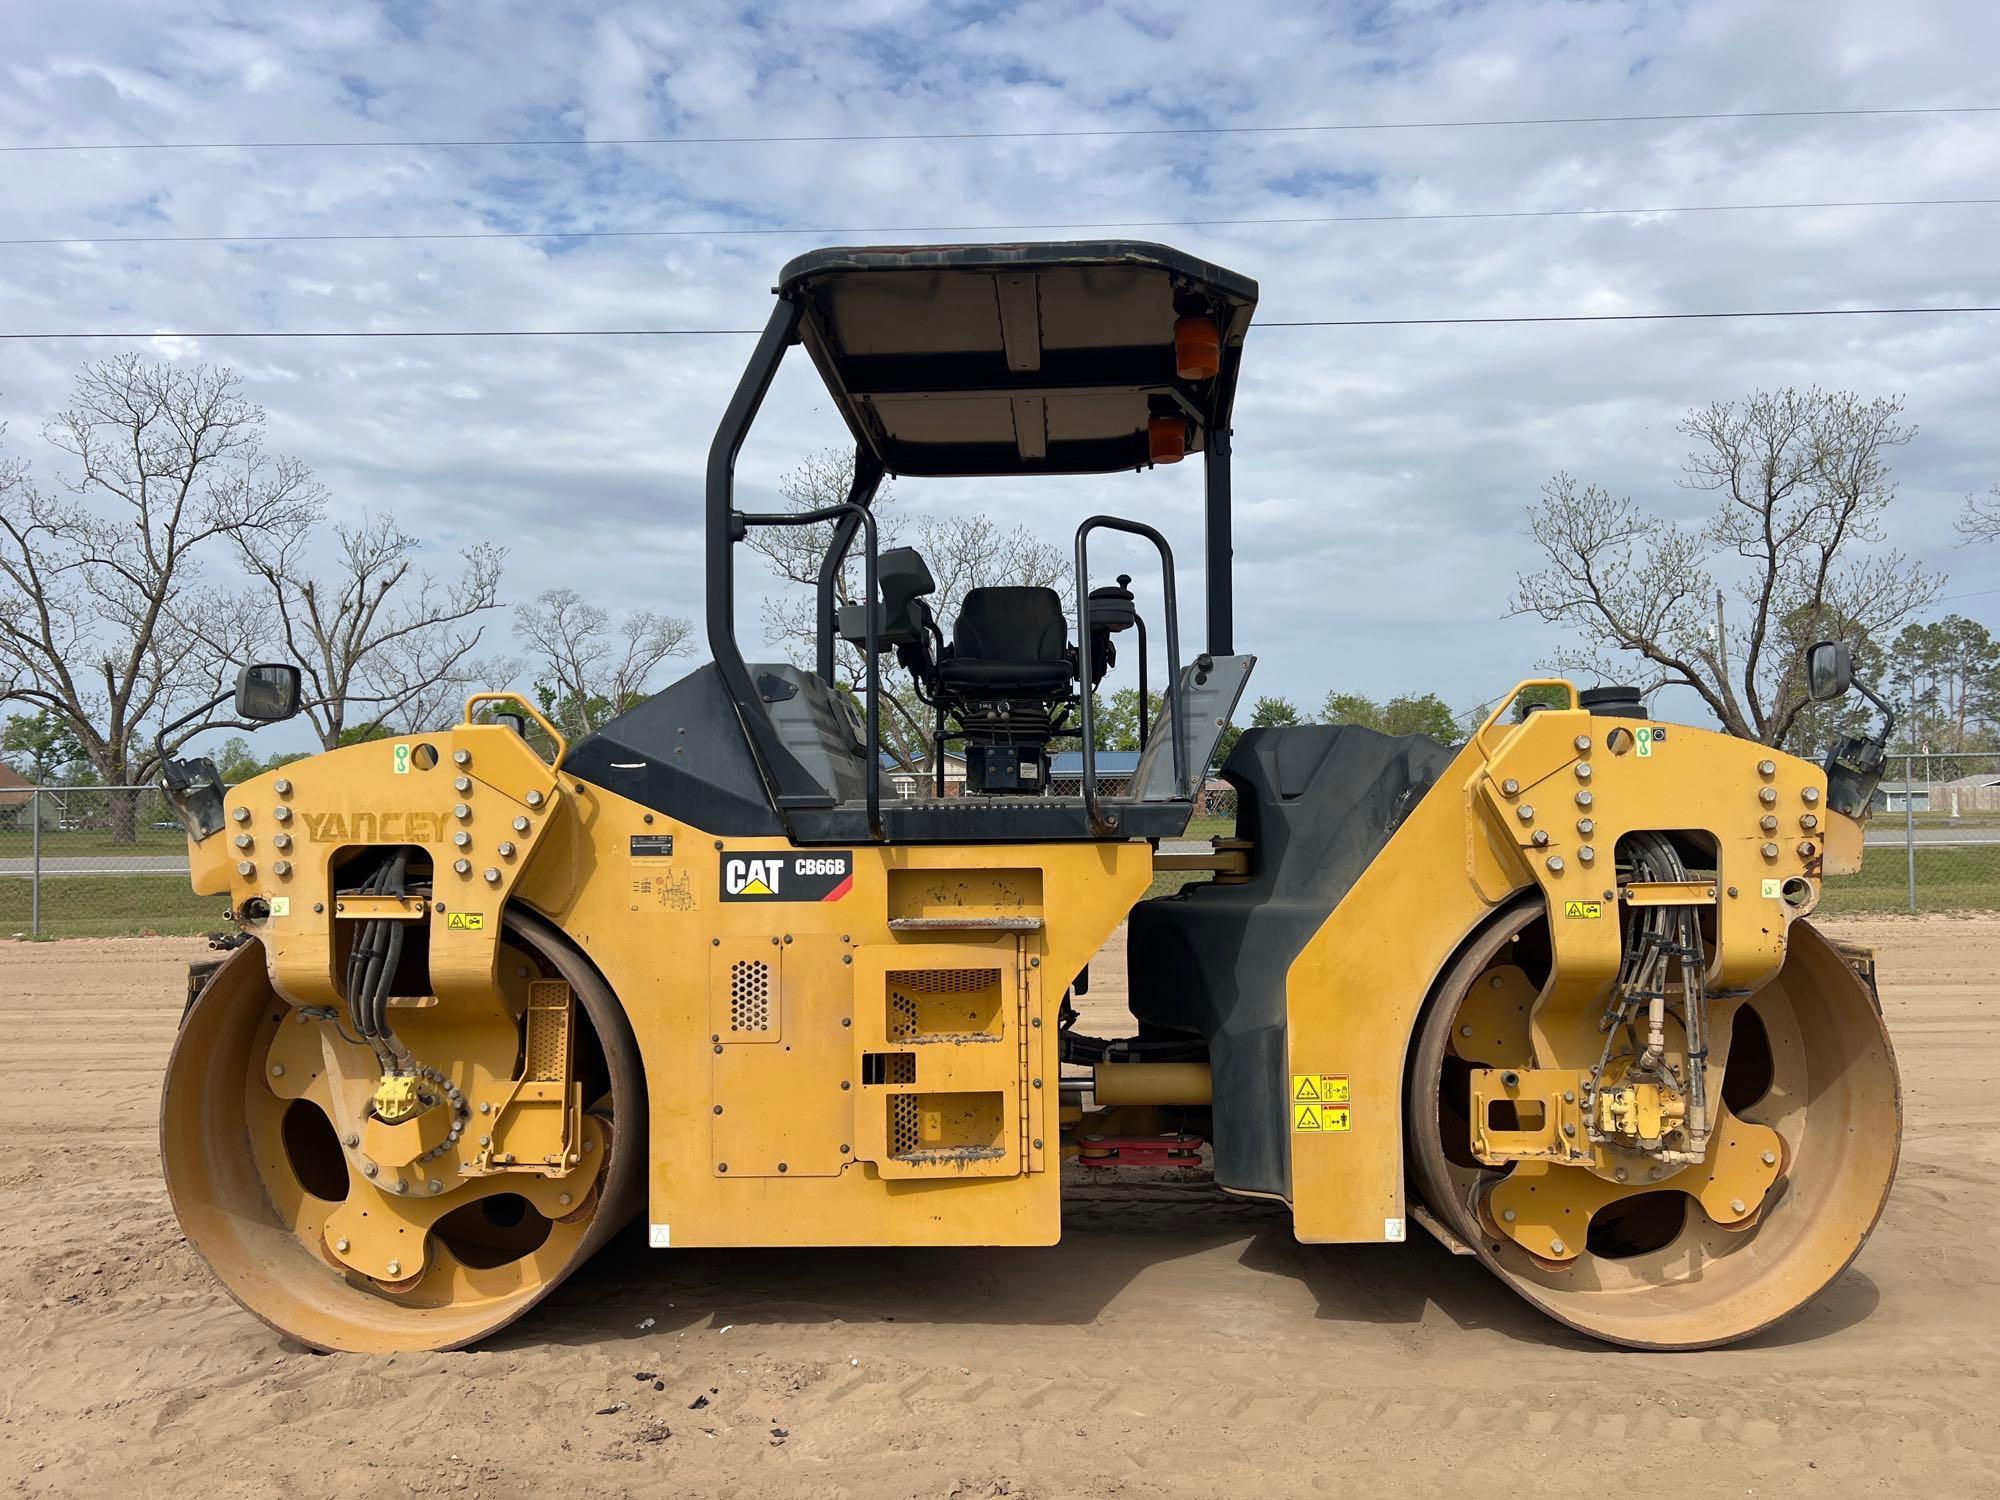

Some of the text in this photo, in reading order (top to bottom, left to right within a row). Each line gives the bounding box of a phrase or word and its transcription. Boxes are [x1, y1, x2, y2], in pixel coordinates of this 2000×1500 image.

[301, 812, 452, 843] YANCEY
[726, 858, 845, 895] CAT CB66B
